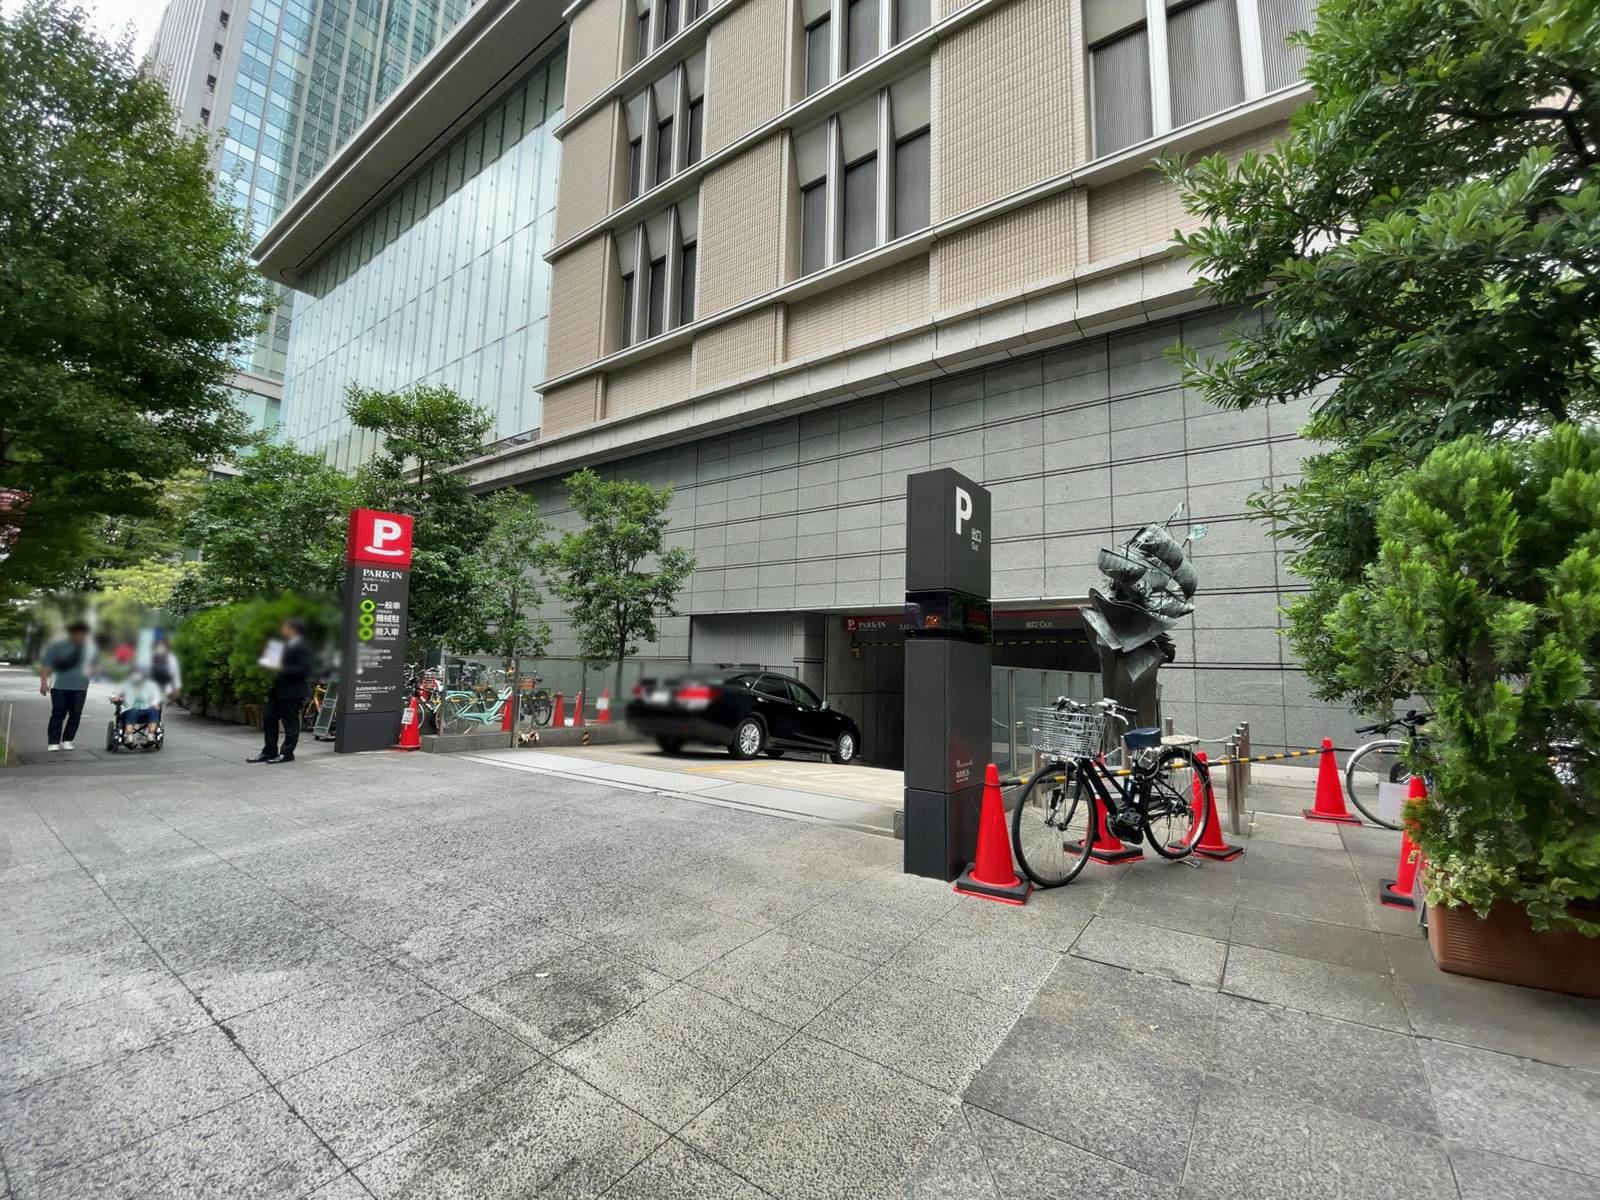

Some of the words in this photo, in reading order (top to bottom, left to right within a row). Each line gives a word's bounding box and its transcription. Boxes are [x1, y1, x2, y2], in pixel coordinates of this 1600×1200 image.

[954, 486, 972, 535] P
[373, 518, 402, 548] P
[971, 527, 982, 543] 出口
[361, 582, 379, 592] 入口
[376, 601, 401, 610] 一般車
